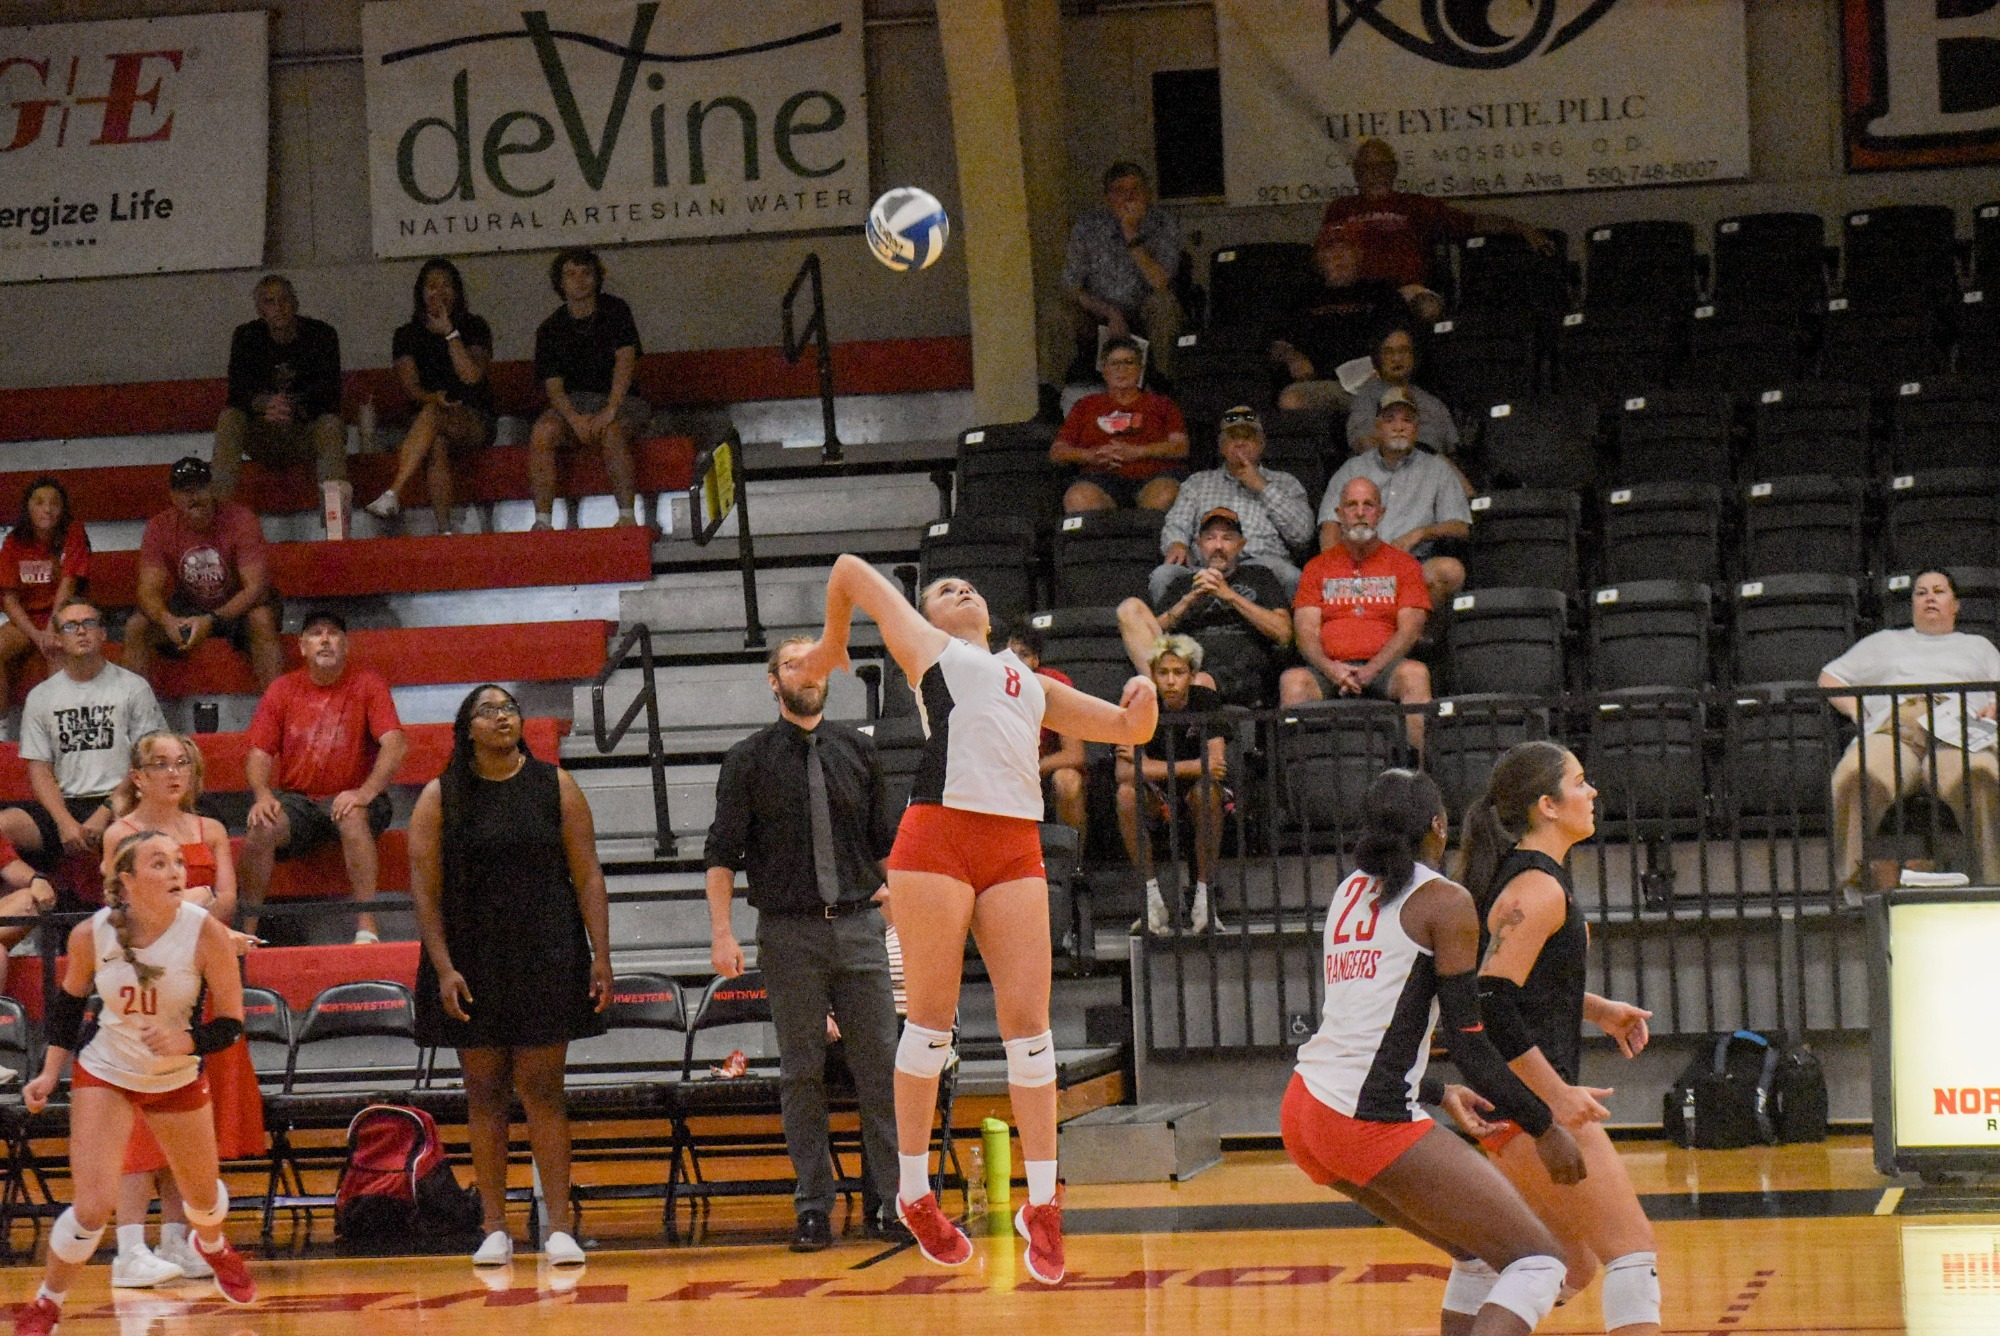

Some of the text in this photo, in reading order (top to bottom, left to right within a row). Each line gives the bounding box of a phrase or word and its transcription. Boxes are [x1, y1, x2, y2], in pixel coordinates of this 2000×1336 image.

[396, 2, 846, 205] deVine
[1398, 106, 1463, 135] EYE
[1555, 94, 1653, 125] PLLC
[110, 188, 174, 222] Life
[400, 187, 854, 237] NATURAL ARTESIAN WATER
[1004, 665, 1021, 698] 8
[53, 705, 115, 732] TRACK
[1333, 876, 1384, 945] 23
[1326, 949, 1382, 985] RANGERS
[120, 986, 158, 1016] 20
[1933, 1087, 2000, 1115] NOR
